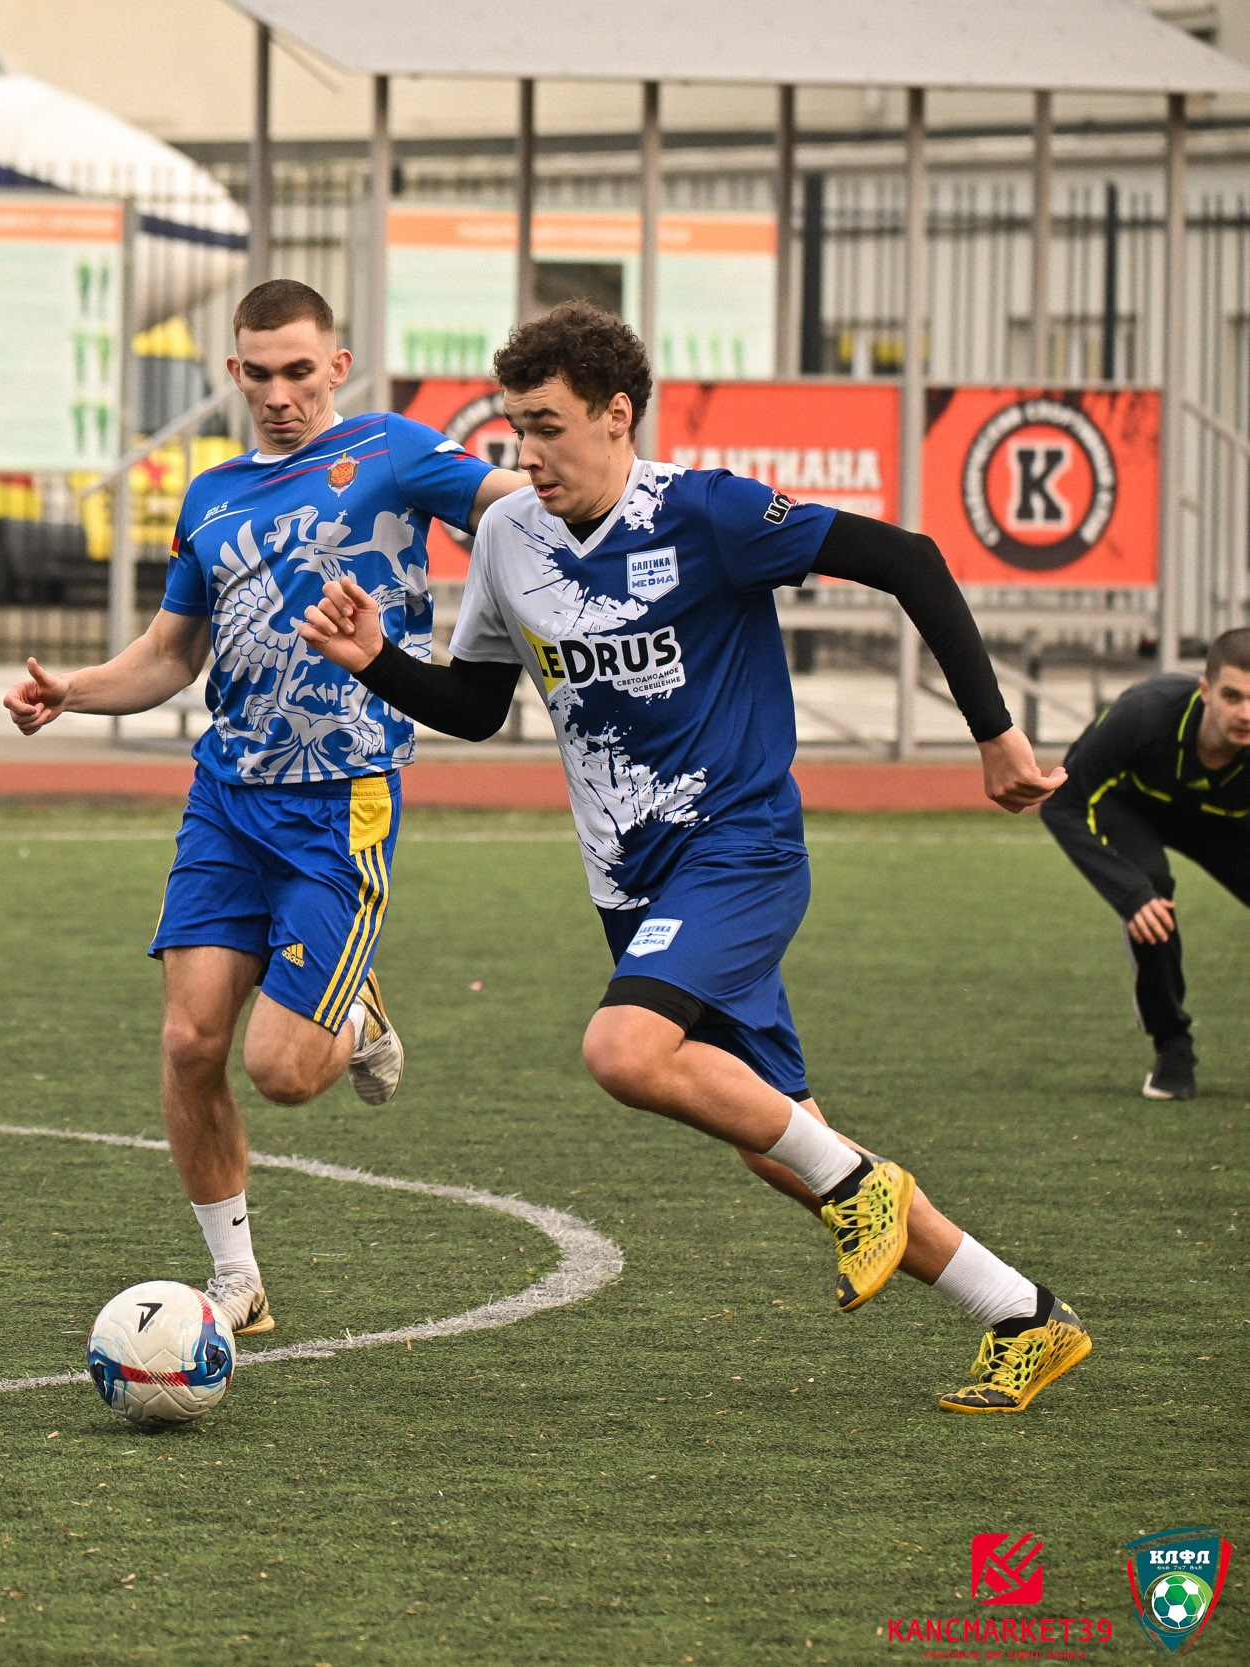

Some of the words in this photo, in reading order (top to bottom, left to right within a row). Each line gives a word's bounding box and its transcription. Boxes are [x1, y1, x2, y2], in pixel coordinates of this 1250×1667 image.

[631, 557, 671, 571] БАЛТИКА
[616, 667, 680, 687] СВЕТОДИОДНОЕ
[632, 676, 681, 693] ОСВЕЩЕНИЕ
[281, 949, 305, 968] adidas
